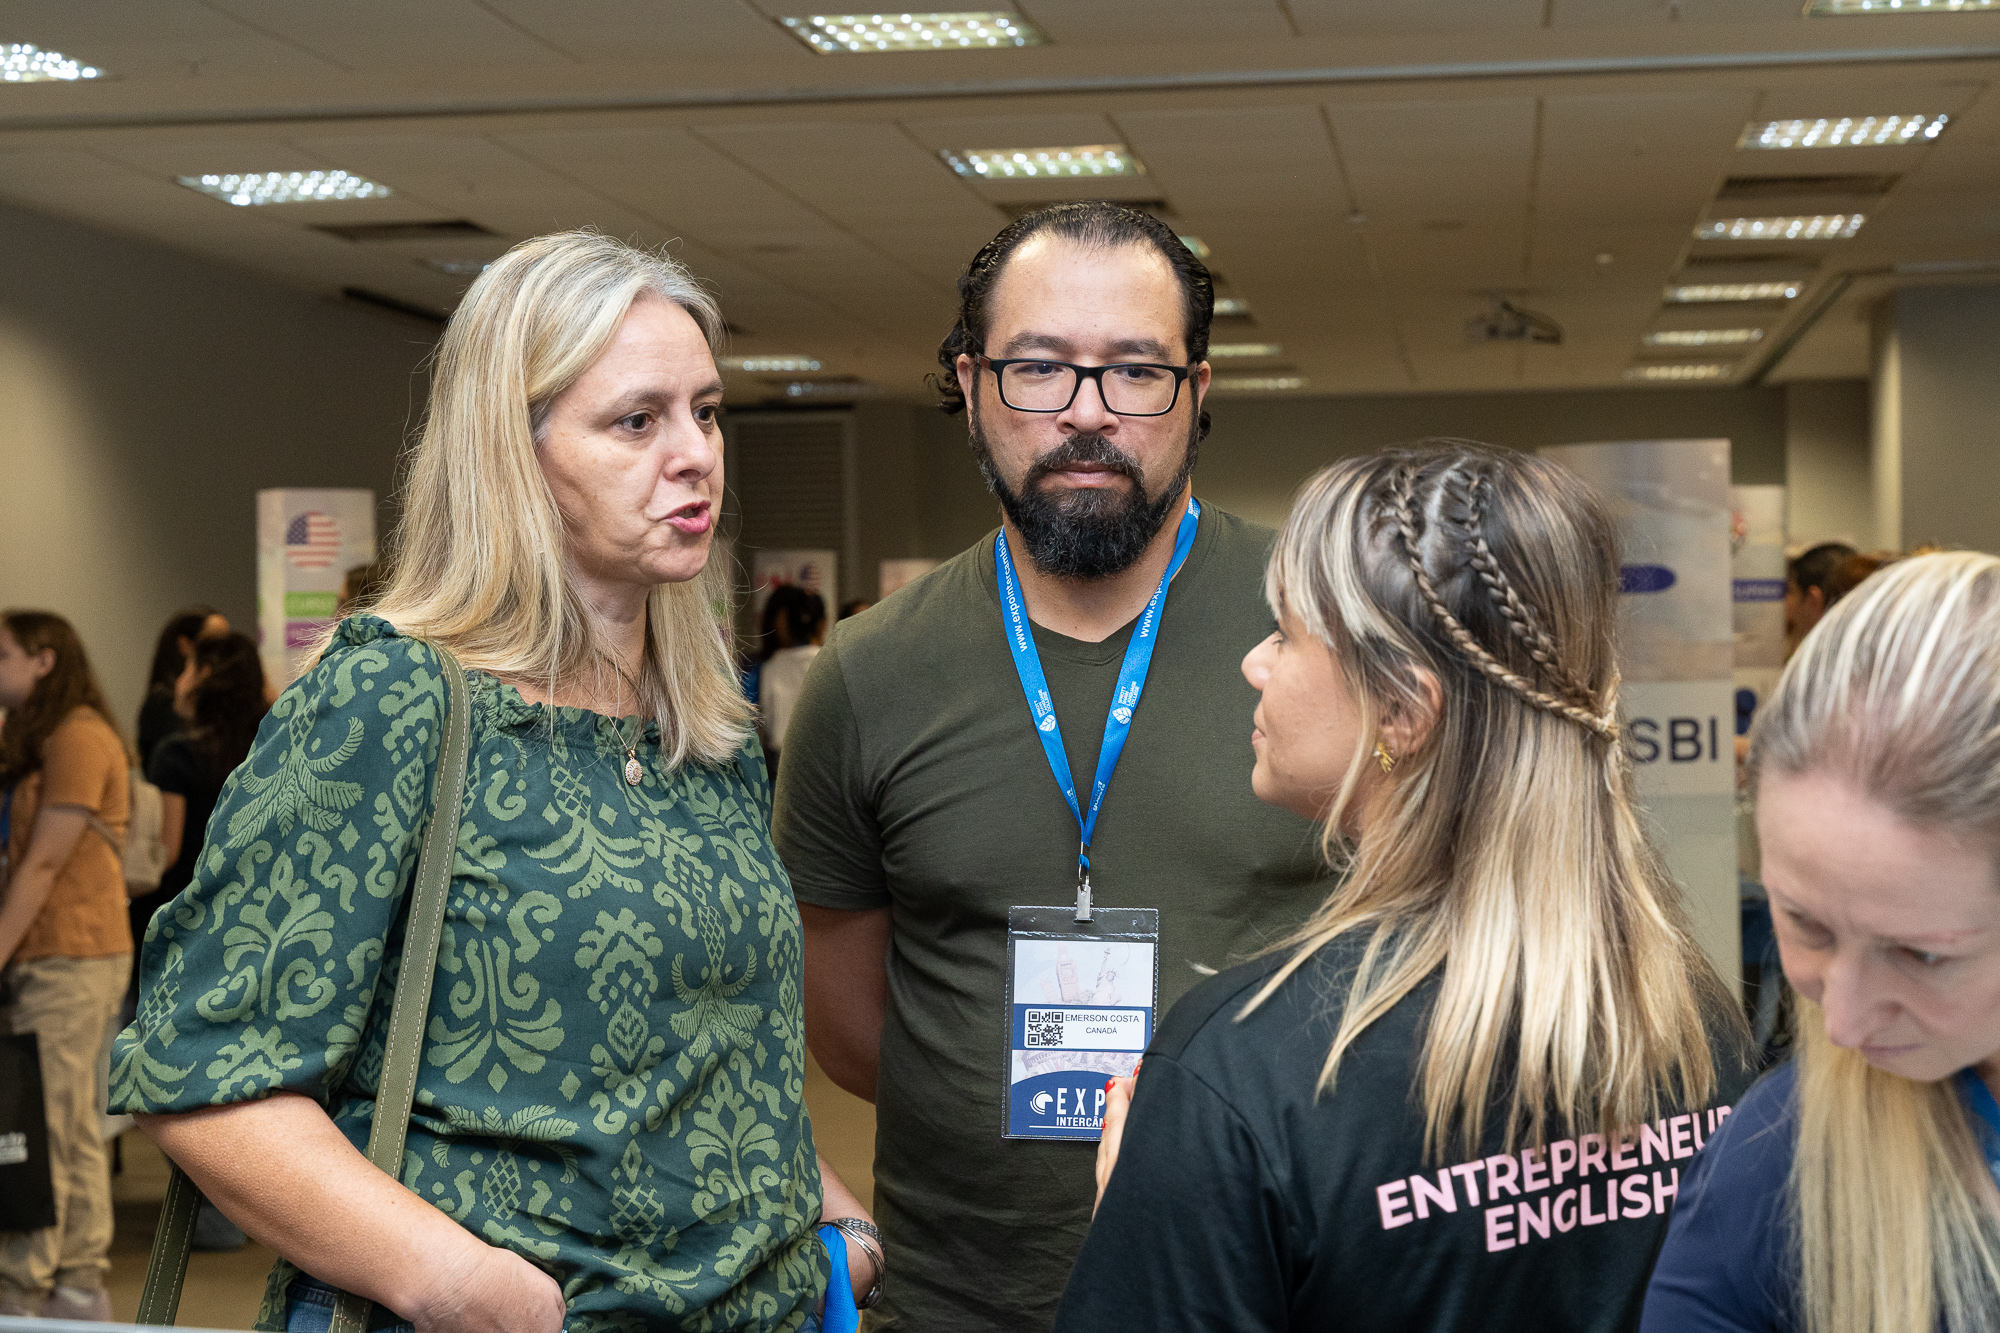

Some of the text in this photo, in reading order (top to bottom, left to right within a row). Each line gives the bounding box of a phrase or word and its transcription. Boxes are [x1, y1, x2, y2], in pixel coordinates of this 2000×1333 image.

[998, 529, 1028, 653] www.expointercambio.
[1140, 570, 1166, 638] www.exp
[1065, 1014, 1140, 1023] EMERSON COSTA
[1056, 1087, 1106, 1116] EXP
[1484, 1168, 1679, 1253] ENGLISH
